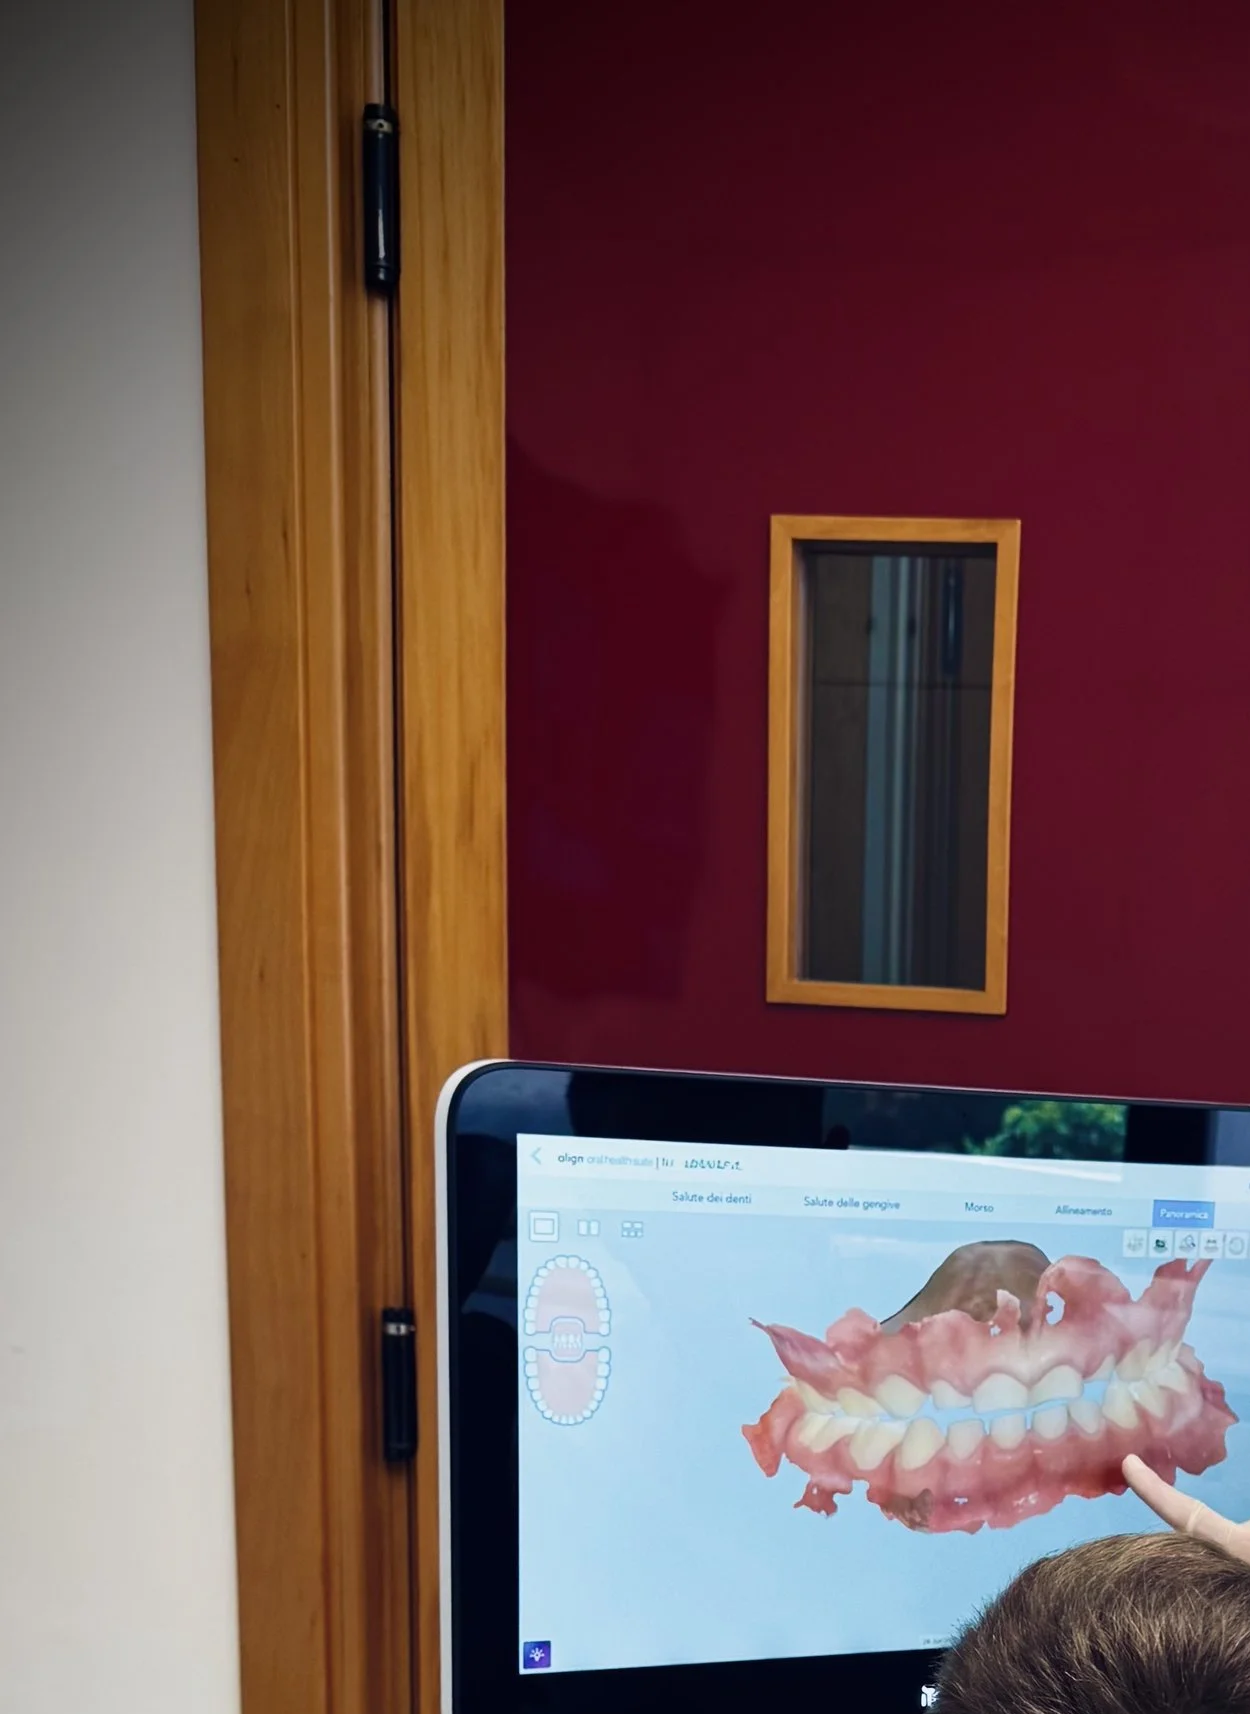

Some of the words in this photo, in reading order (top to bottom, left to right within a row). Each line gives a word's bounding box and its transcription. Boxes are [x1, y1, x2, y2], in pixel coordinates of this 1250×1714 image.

[558, 1153, 584, 1165] align
[672, 1191, 704, 1203] Salute
[706, 1193, 723, 1204] dei
[725, 1193, 752, 1204] denti
[803, 1196, 833, 1207] Salute
[836, 1197, 860, 1208] delle
[862, 1199, 901, 1211] gengive
[964, 1202, 994, 1213] Morso
[1055, 1205, 1112, 1217] Allineamento
[1159, 1208, 1209, 1220] Panoramica
